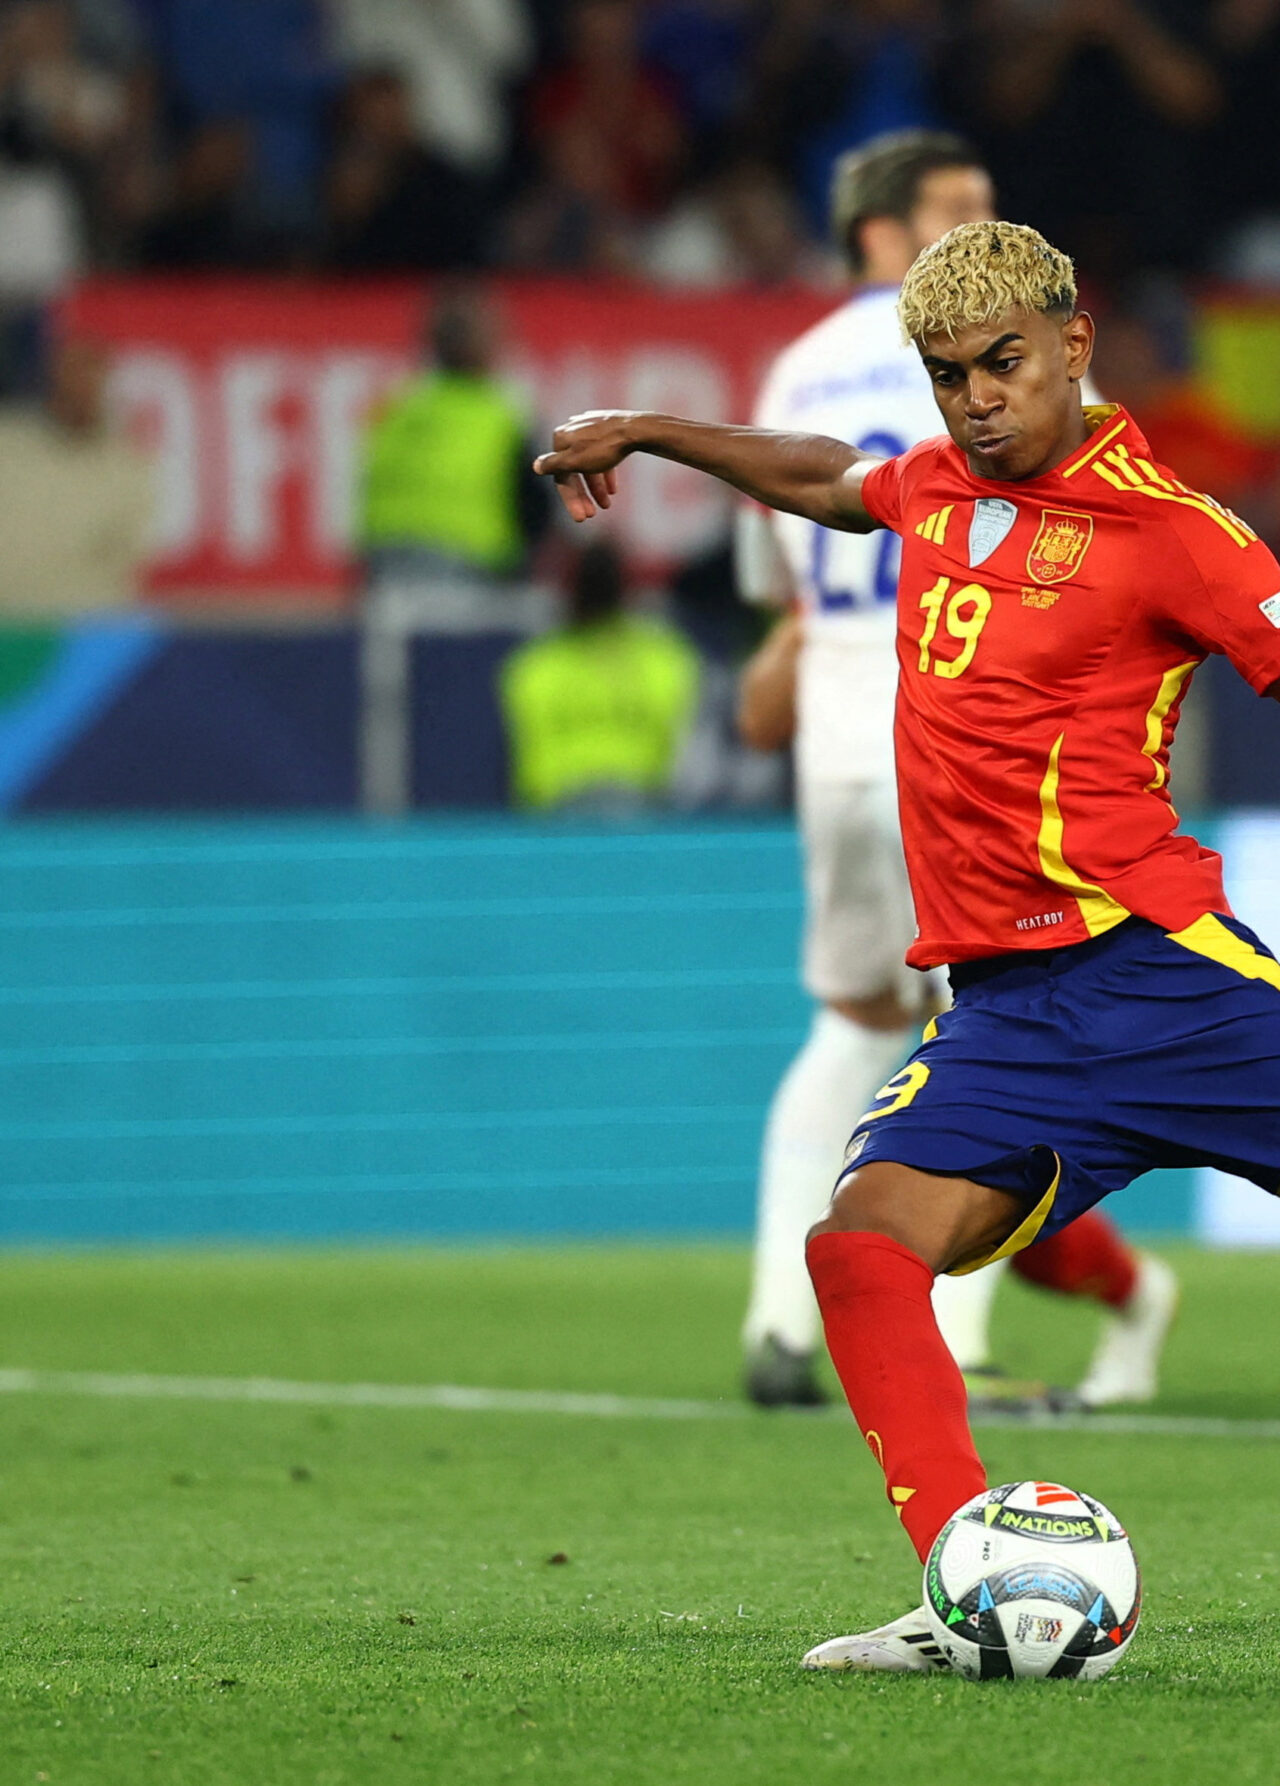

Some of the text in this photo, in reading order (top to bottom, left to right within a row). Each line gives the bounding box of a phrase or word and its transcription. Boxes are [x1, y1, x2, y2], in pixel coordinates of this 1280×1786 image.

[918, 576, 992, 679] 19
[1006, 1512, 1094, 1537] NATIONS
[982, 1541, 991, 1561] PRO
